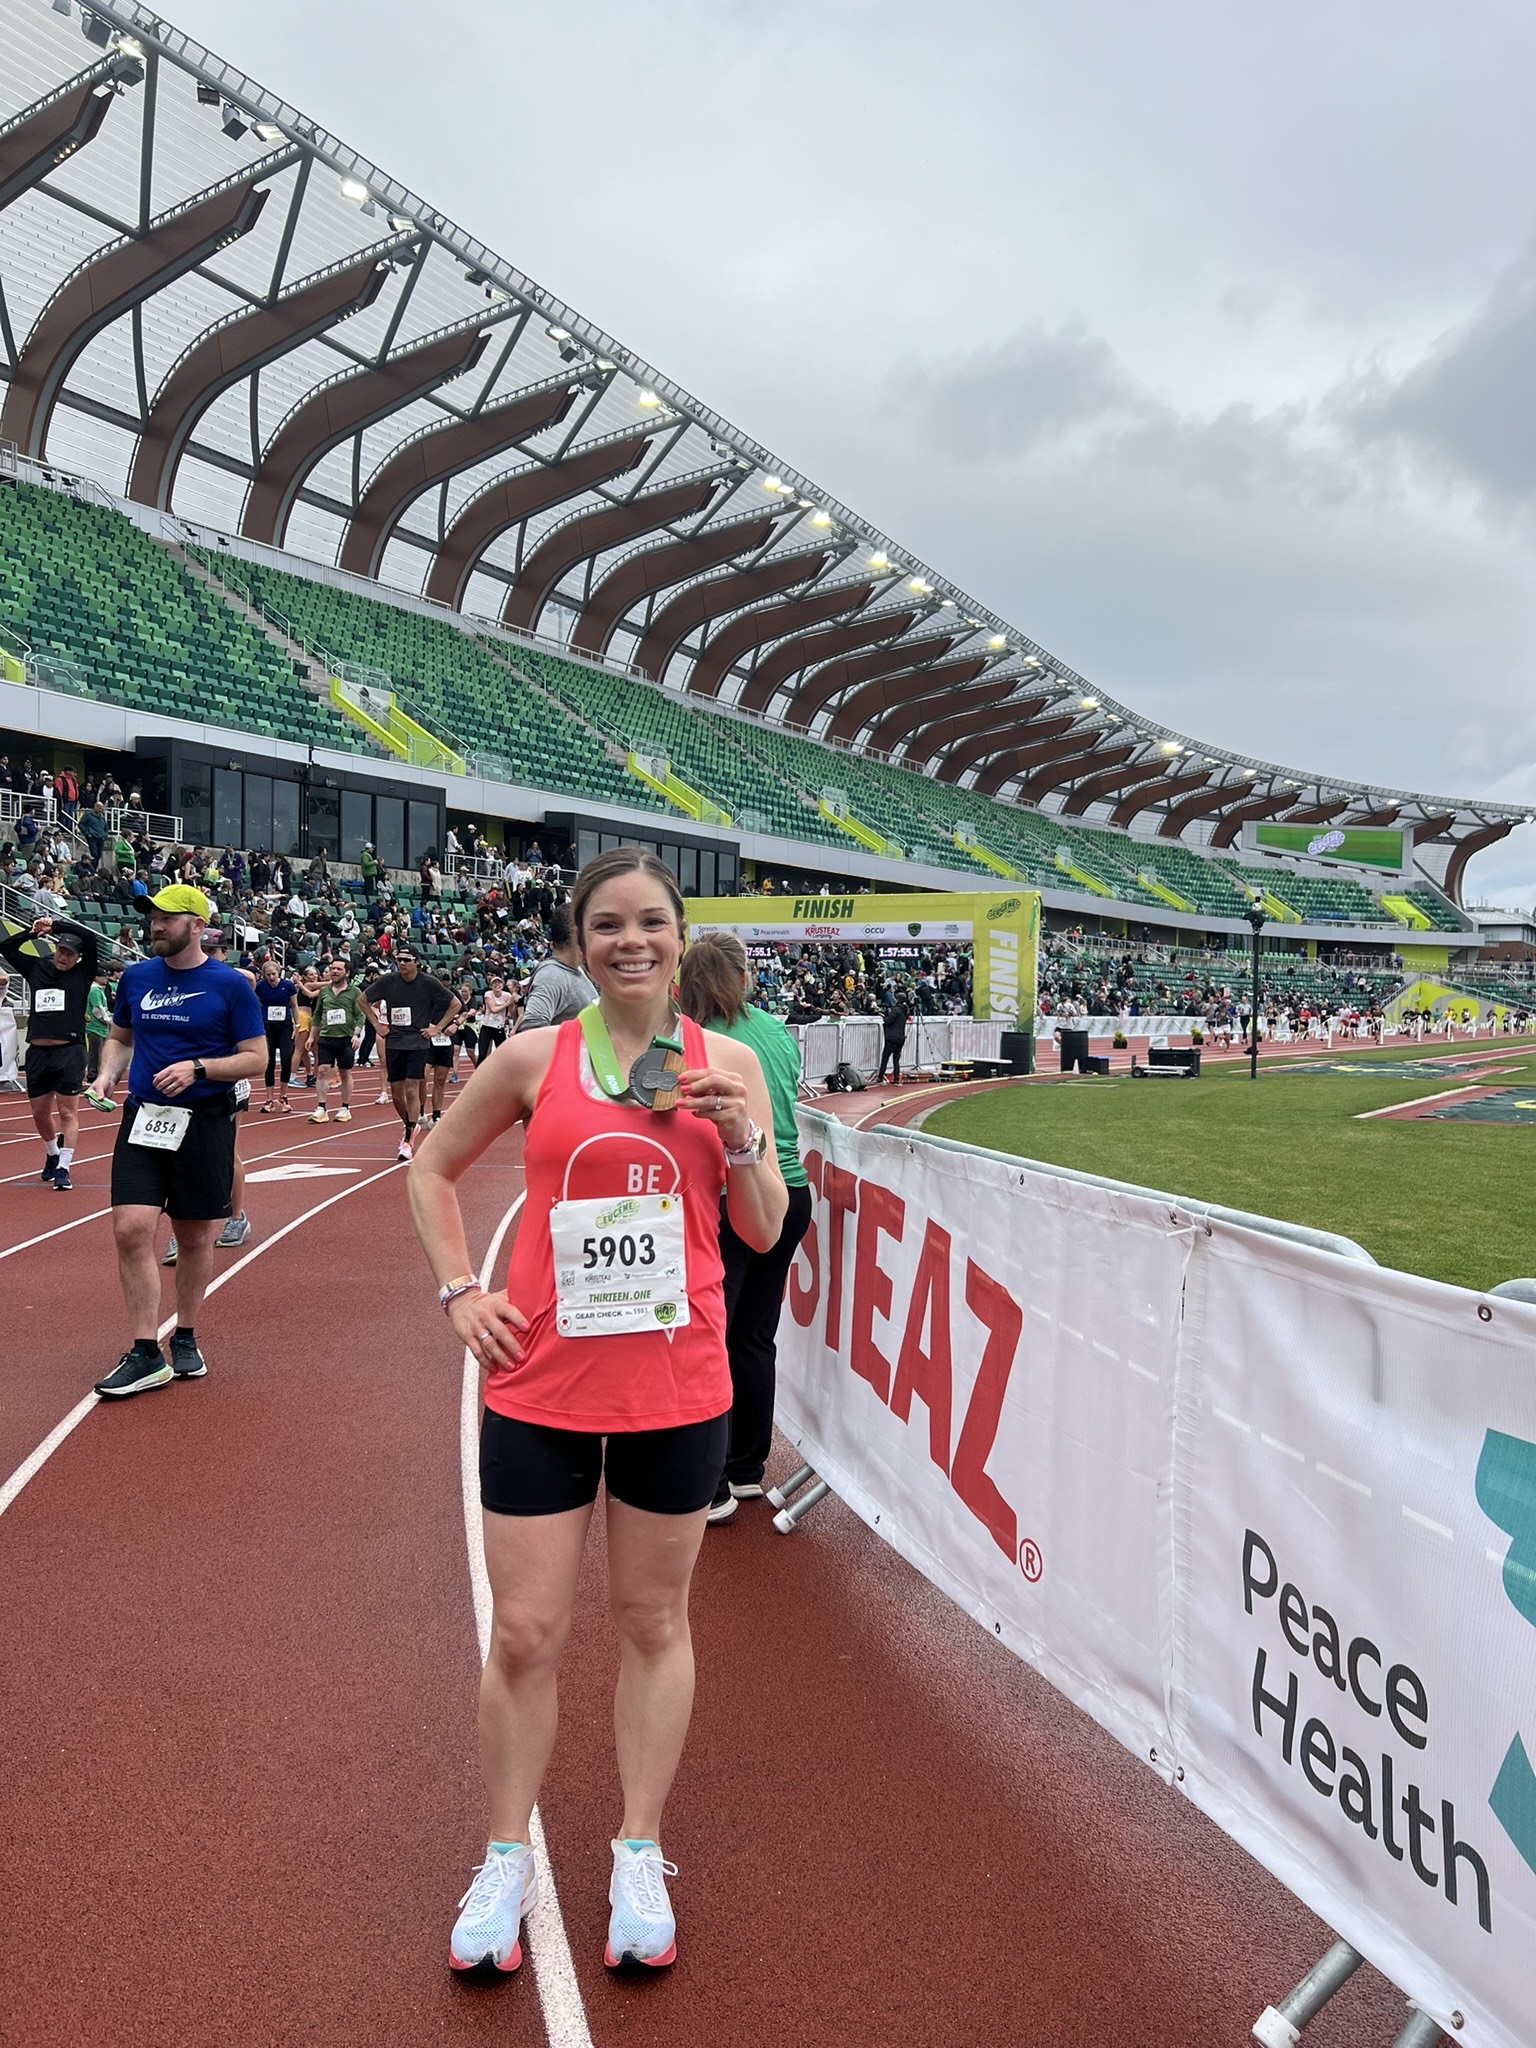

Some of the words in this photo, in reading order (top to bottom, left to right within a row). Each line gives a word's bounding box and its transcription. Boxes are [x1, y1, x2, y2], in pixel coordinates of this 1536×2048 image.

[792, 899, 855, 918] FINISH
[805, 926, 840, 937] KRUSTEAZ
[879, 947, 919, 957] 1:57:55.1
[989, 929, 1019, 1020] FINIS
[145, 1119, 177, 1135] 6854
[627, 1163, 662, 1194] BE
[602, 1201, 634, 1225] EUGENE
[583, 1233, 656, 1269] 5903
[588, 1289, 652, 1303] THIRTEEN.ONE
[575, 1312, 595, 1320] GEAR
[596, 1311, 623, 1319] CHECK
[782, 1148, 1023, 1567] STEAZ
[1242, 1528, 1429, 1750] Peace
[1252, 1647, 1492, 1934] Health
